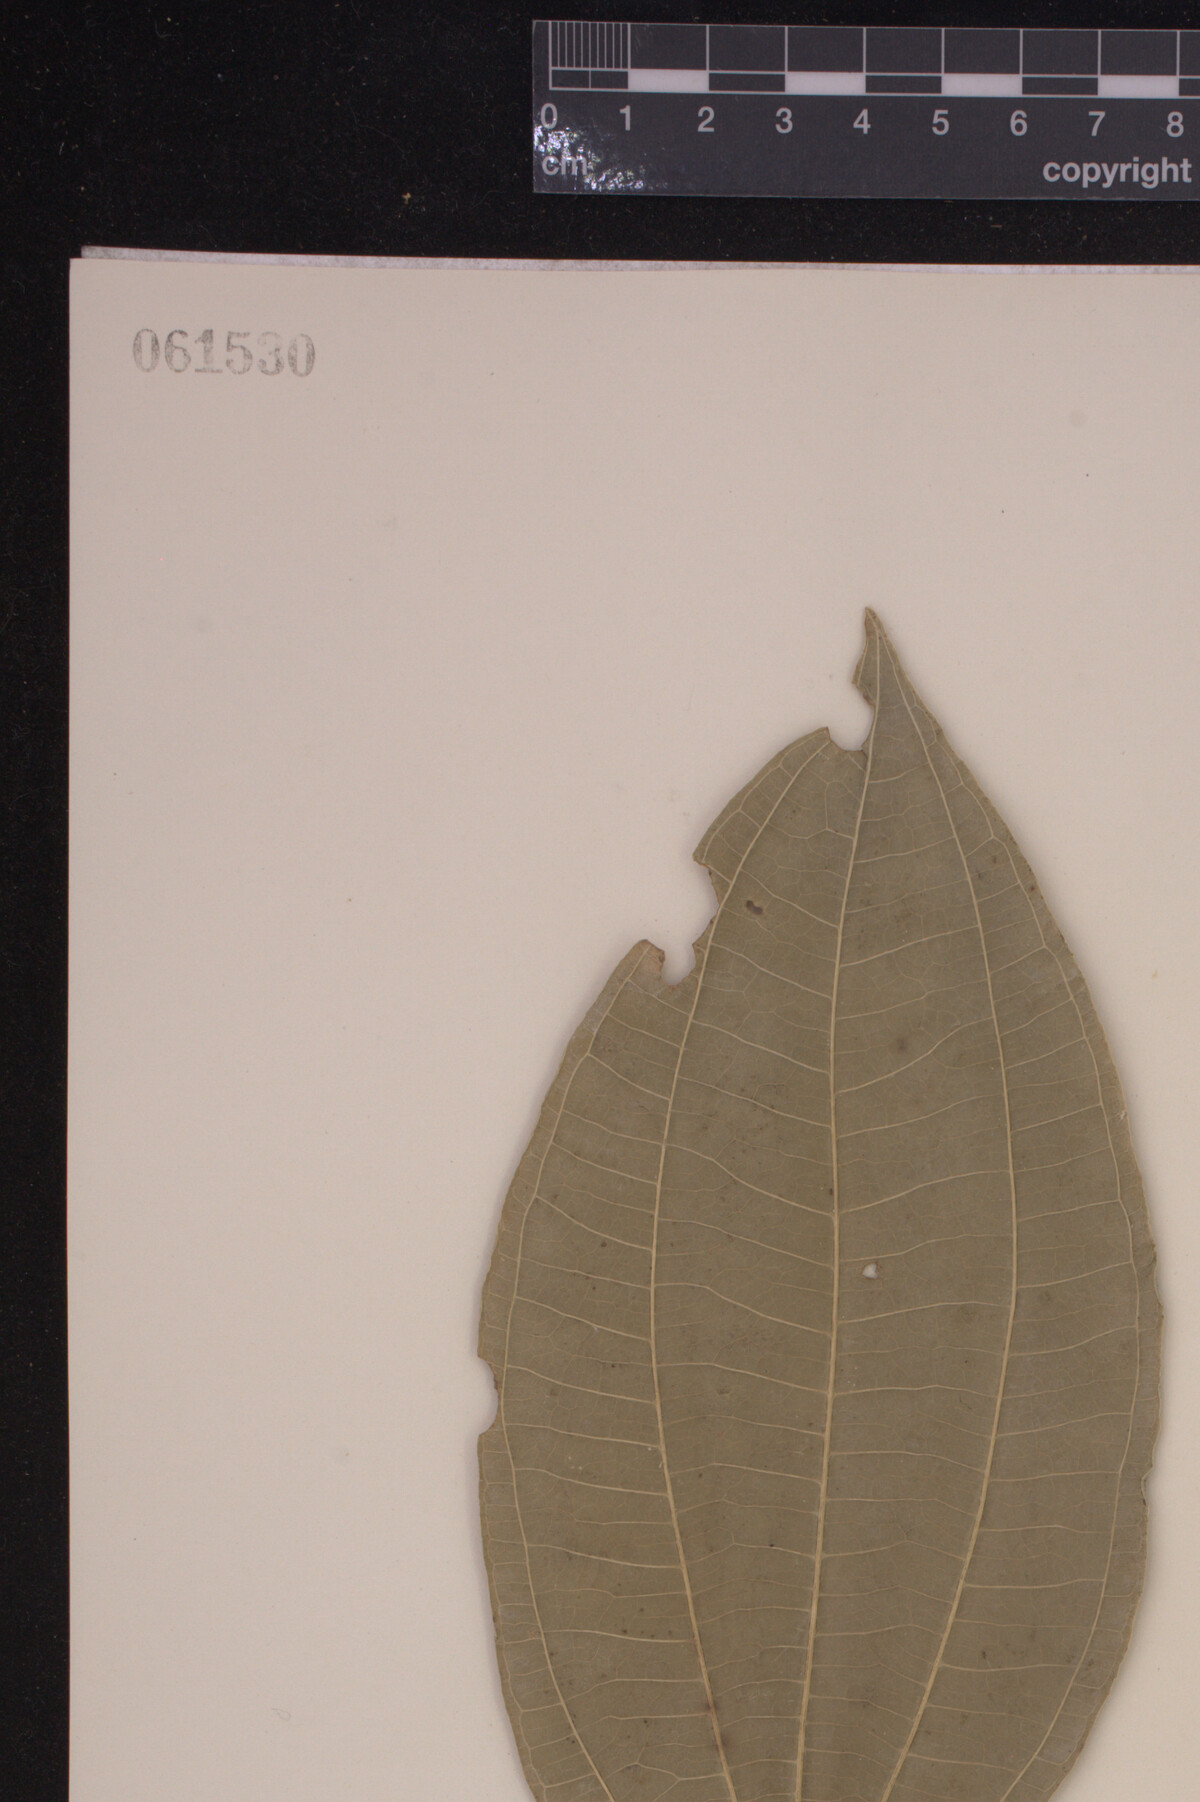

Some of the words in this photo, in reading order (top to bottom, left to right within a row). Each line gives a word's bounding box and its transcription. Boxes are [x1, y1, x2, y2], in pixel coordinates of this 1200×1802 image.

[540, 103, 558, 129] 0
[619, 105, 631, 130] 1
[697, 106, 715, 132] 2
[775, 107, 793, 133] 3
[853, 109, 871, 135] 4
[931, 109, 949, 135] 5
[1009, 110, 1027, 136] 6
[1088, 111, 1105, 137] 7
[1166, 112, 1184, 137] 8
[541, 152, 588, 176] cm
[1043, 158, 1191, 189] copyright
[133, 329, 316, 377] 061530
